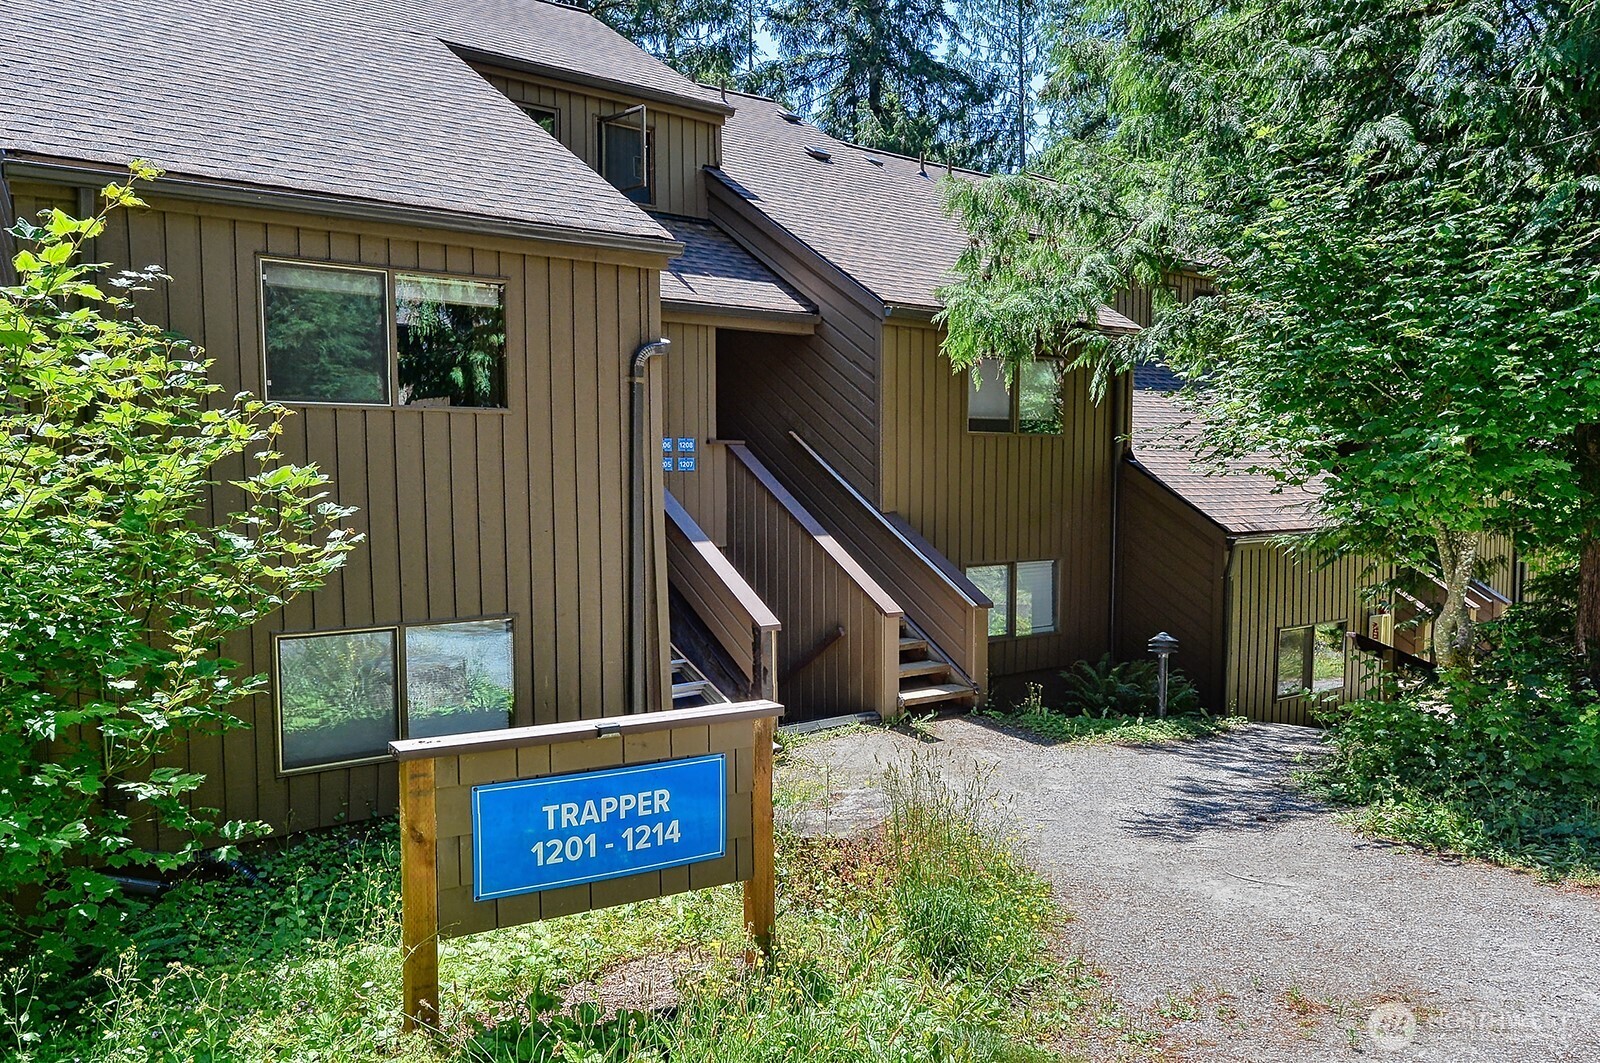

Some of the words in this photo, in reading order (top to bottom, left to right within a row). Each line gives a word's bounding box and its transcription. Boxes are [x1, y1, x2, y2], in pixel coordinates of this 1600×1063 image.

[679, 441, 694, 449] 1208
[542, 788, 671, 831] TRAPPER
[531, 833, 597, 867] 1201
[621, 819, 681, 852] 1214
